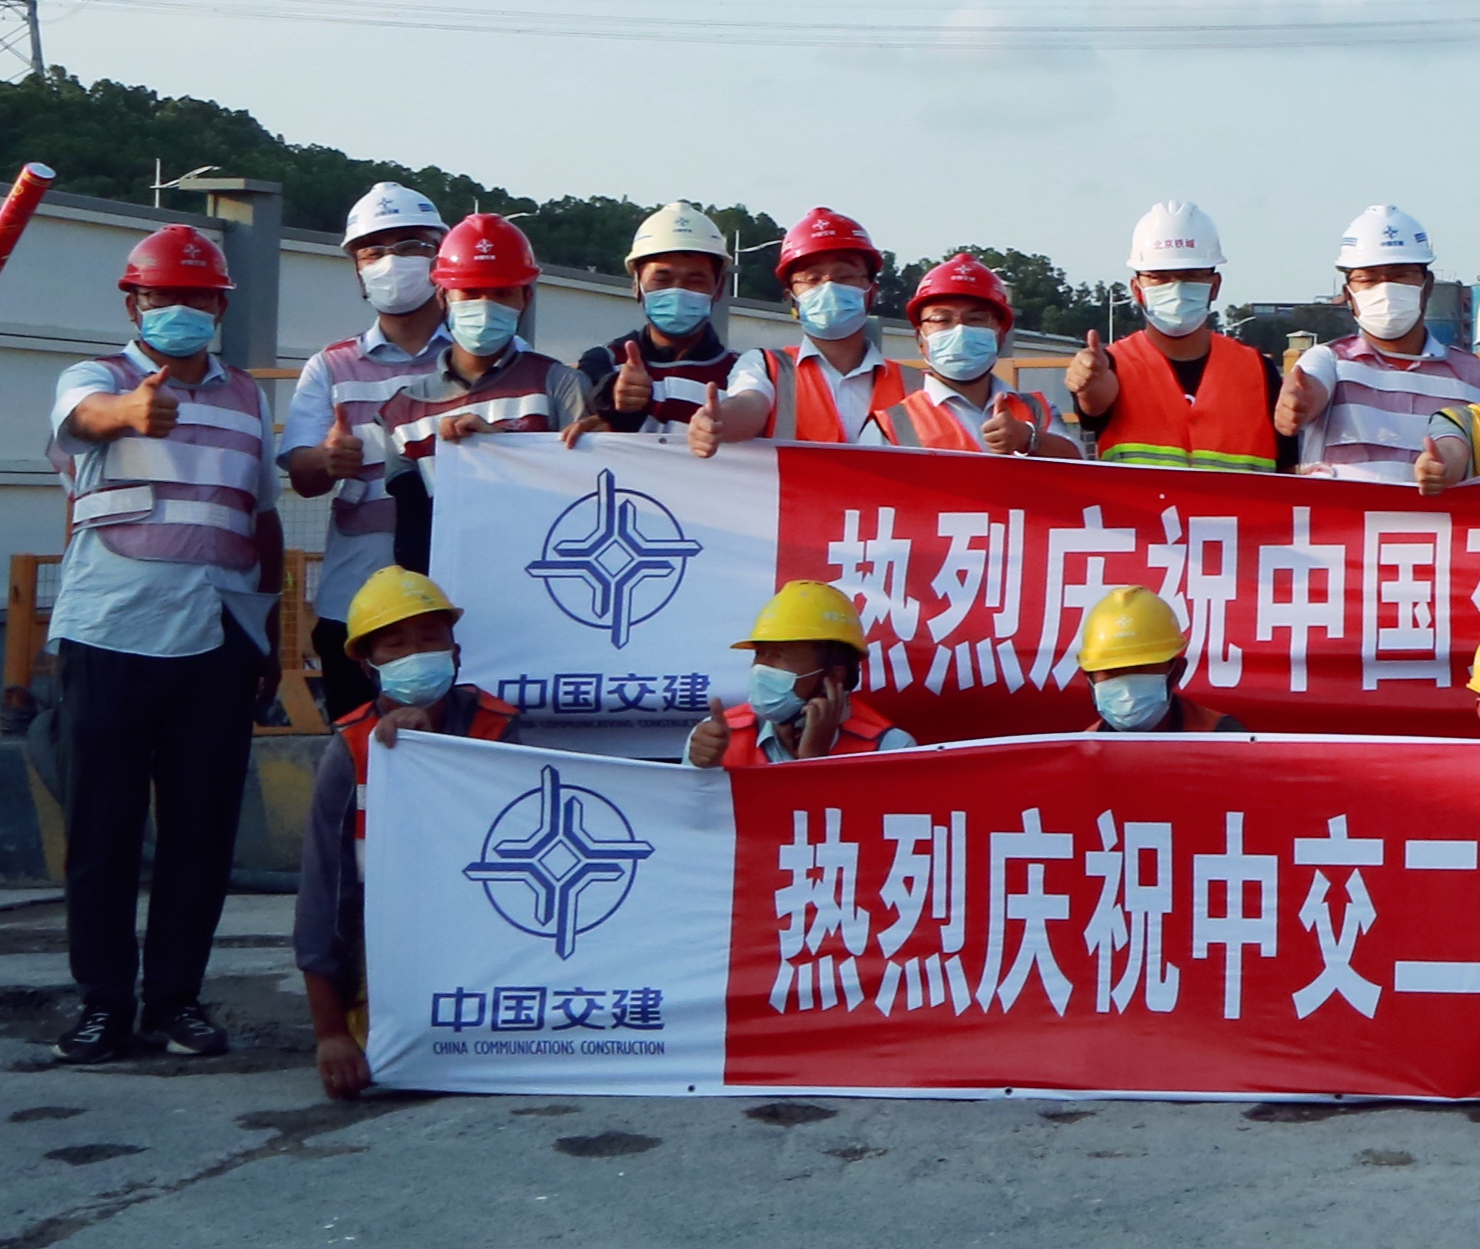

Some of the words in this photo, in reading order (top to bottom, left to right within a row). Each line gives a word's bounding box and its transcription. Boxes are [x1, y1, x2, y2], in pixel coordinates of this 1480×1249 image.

[498, 672, 712, 715] 中国交建
[431, 986, 666, 1033] 中国交建
[433, 1041, 469, 1055] CHINA
[473, 1040, 576, 1056] COMMUNICATIONS
[580, 1040, 666, 1056] CONSTRUCTION
